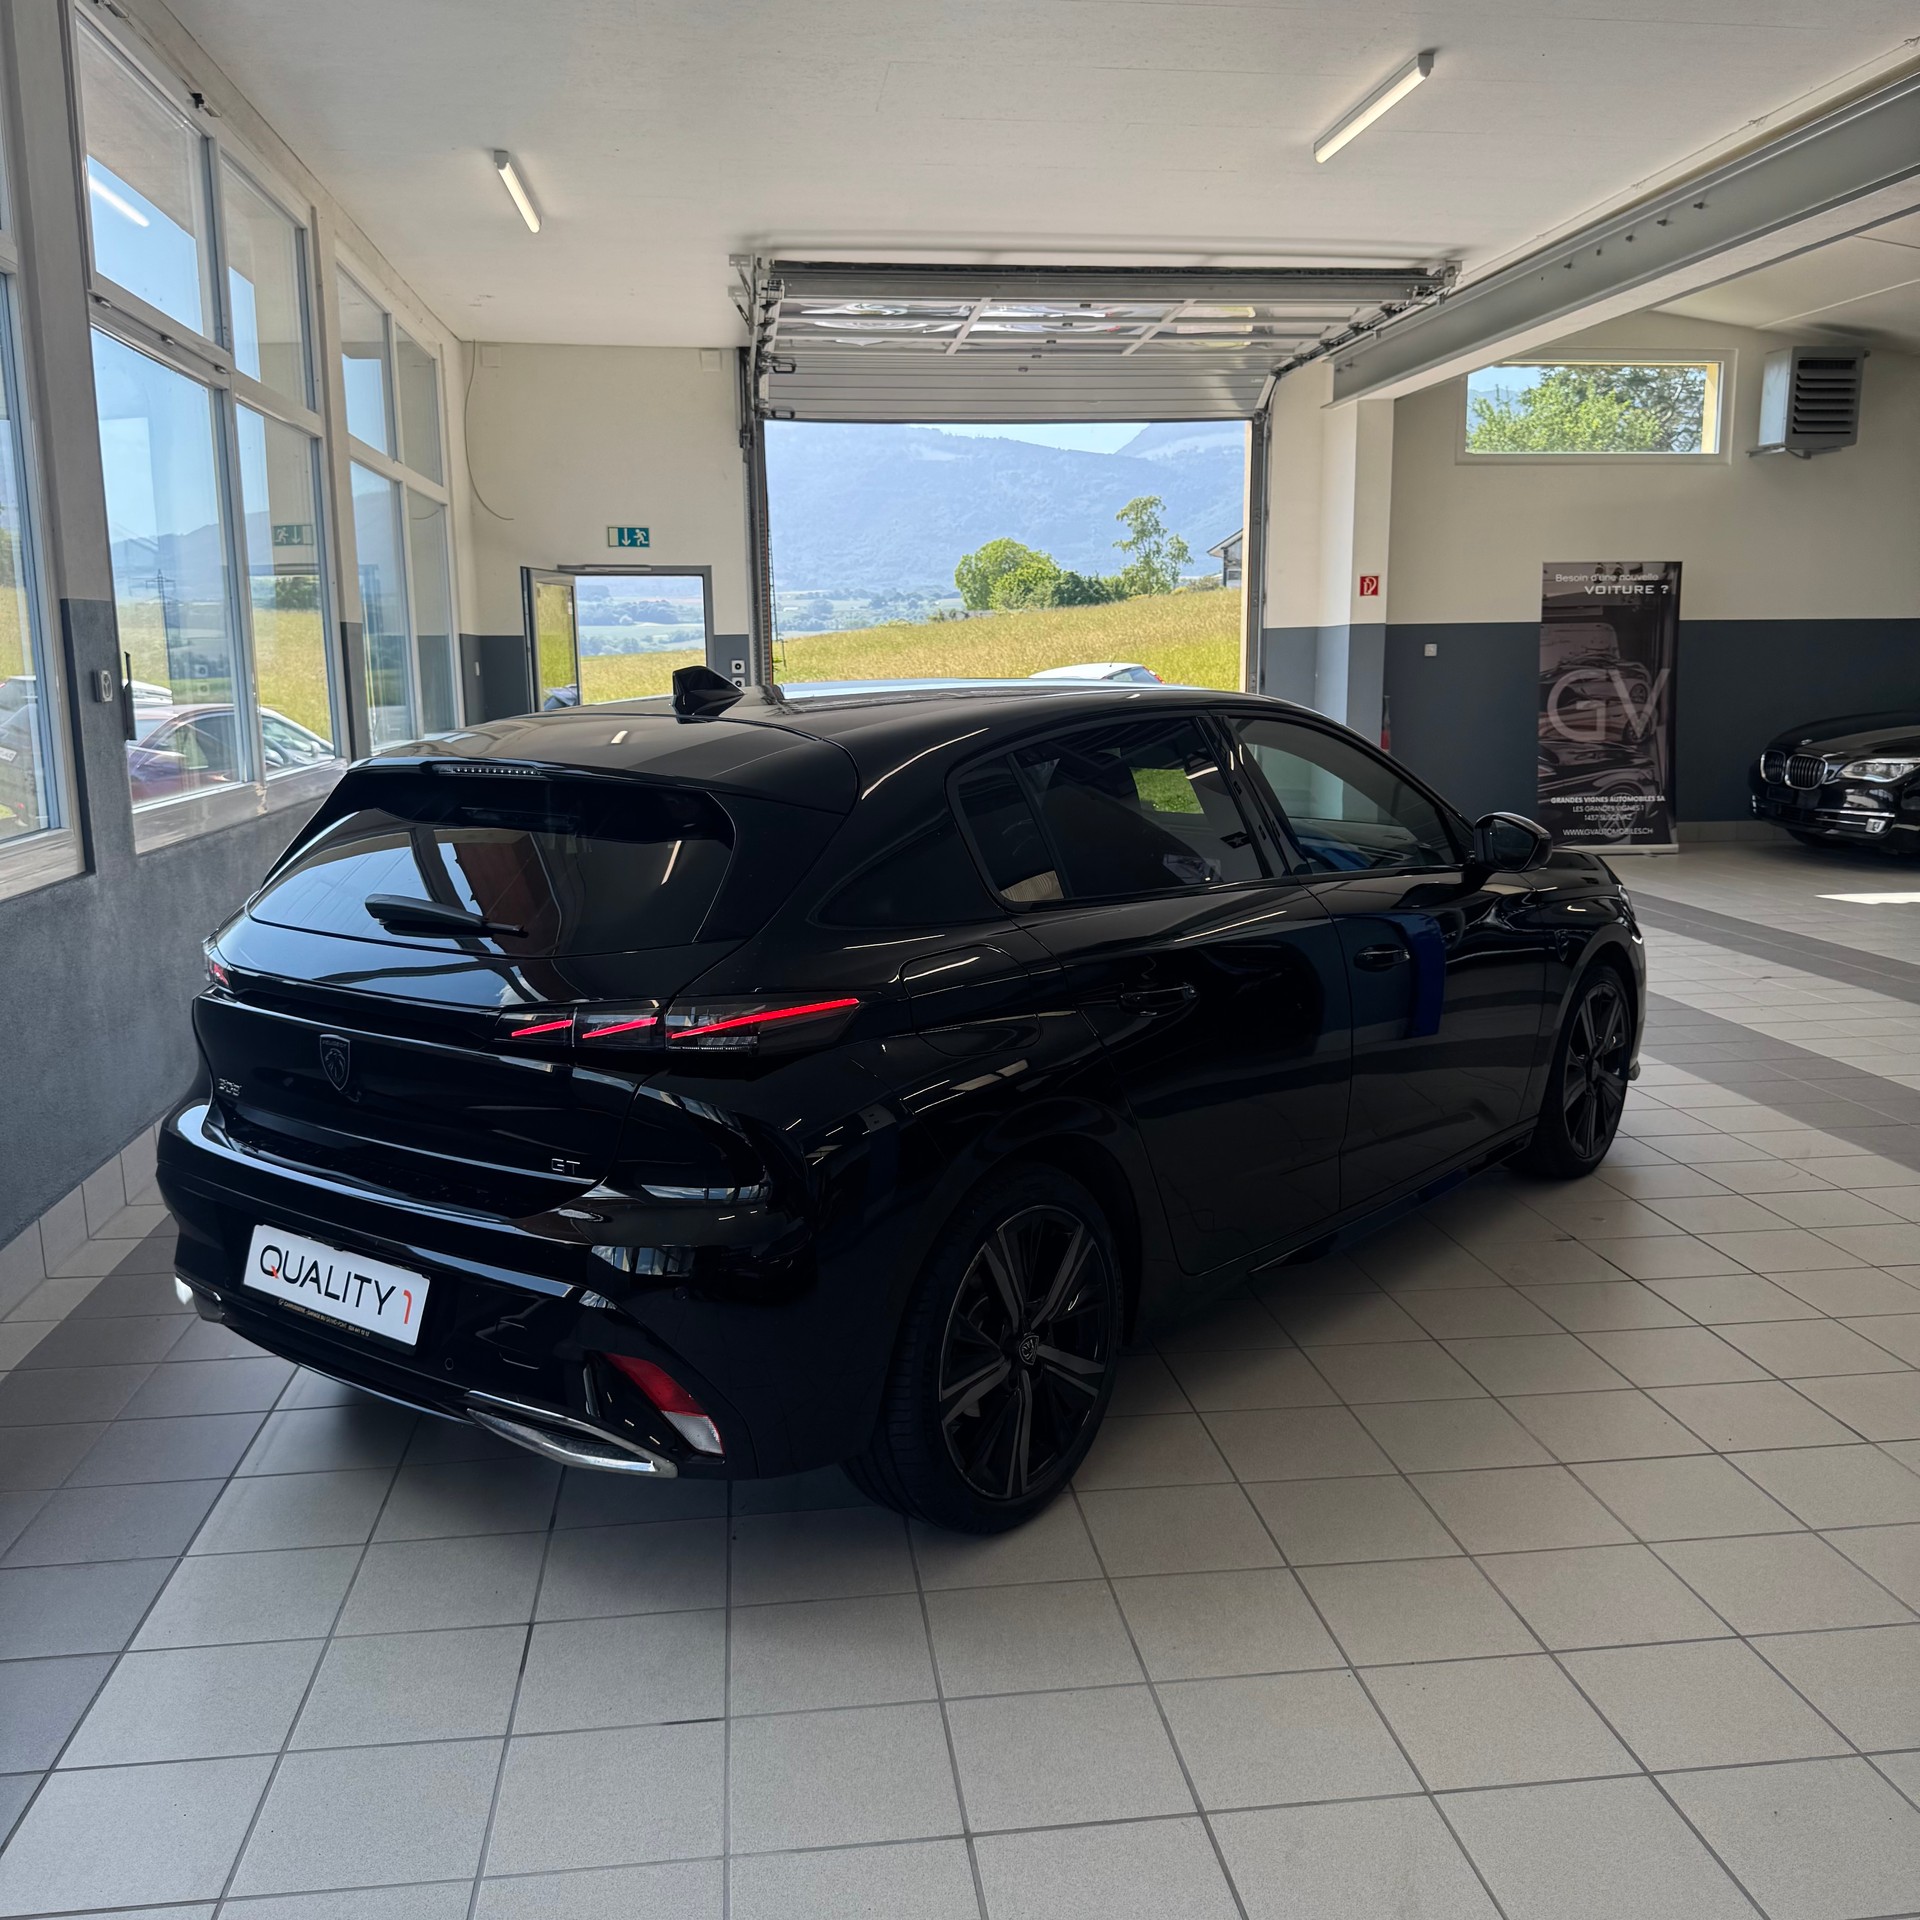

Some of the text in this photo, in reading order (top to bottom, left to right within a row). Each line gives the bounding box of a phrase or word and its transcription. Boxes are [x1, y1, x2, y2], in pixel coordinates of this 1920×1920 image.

[1555, 574, 1588, 582] Besoin
[1591, 573, 1617, 582] d'une
[1584, 585, 1669, 595] VOITURE ?
[1547, 668, 1671, 743] GV
[551, 1158, 581, 1176] GT
